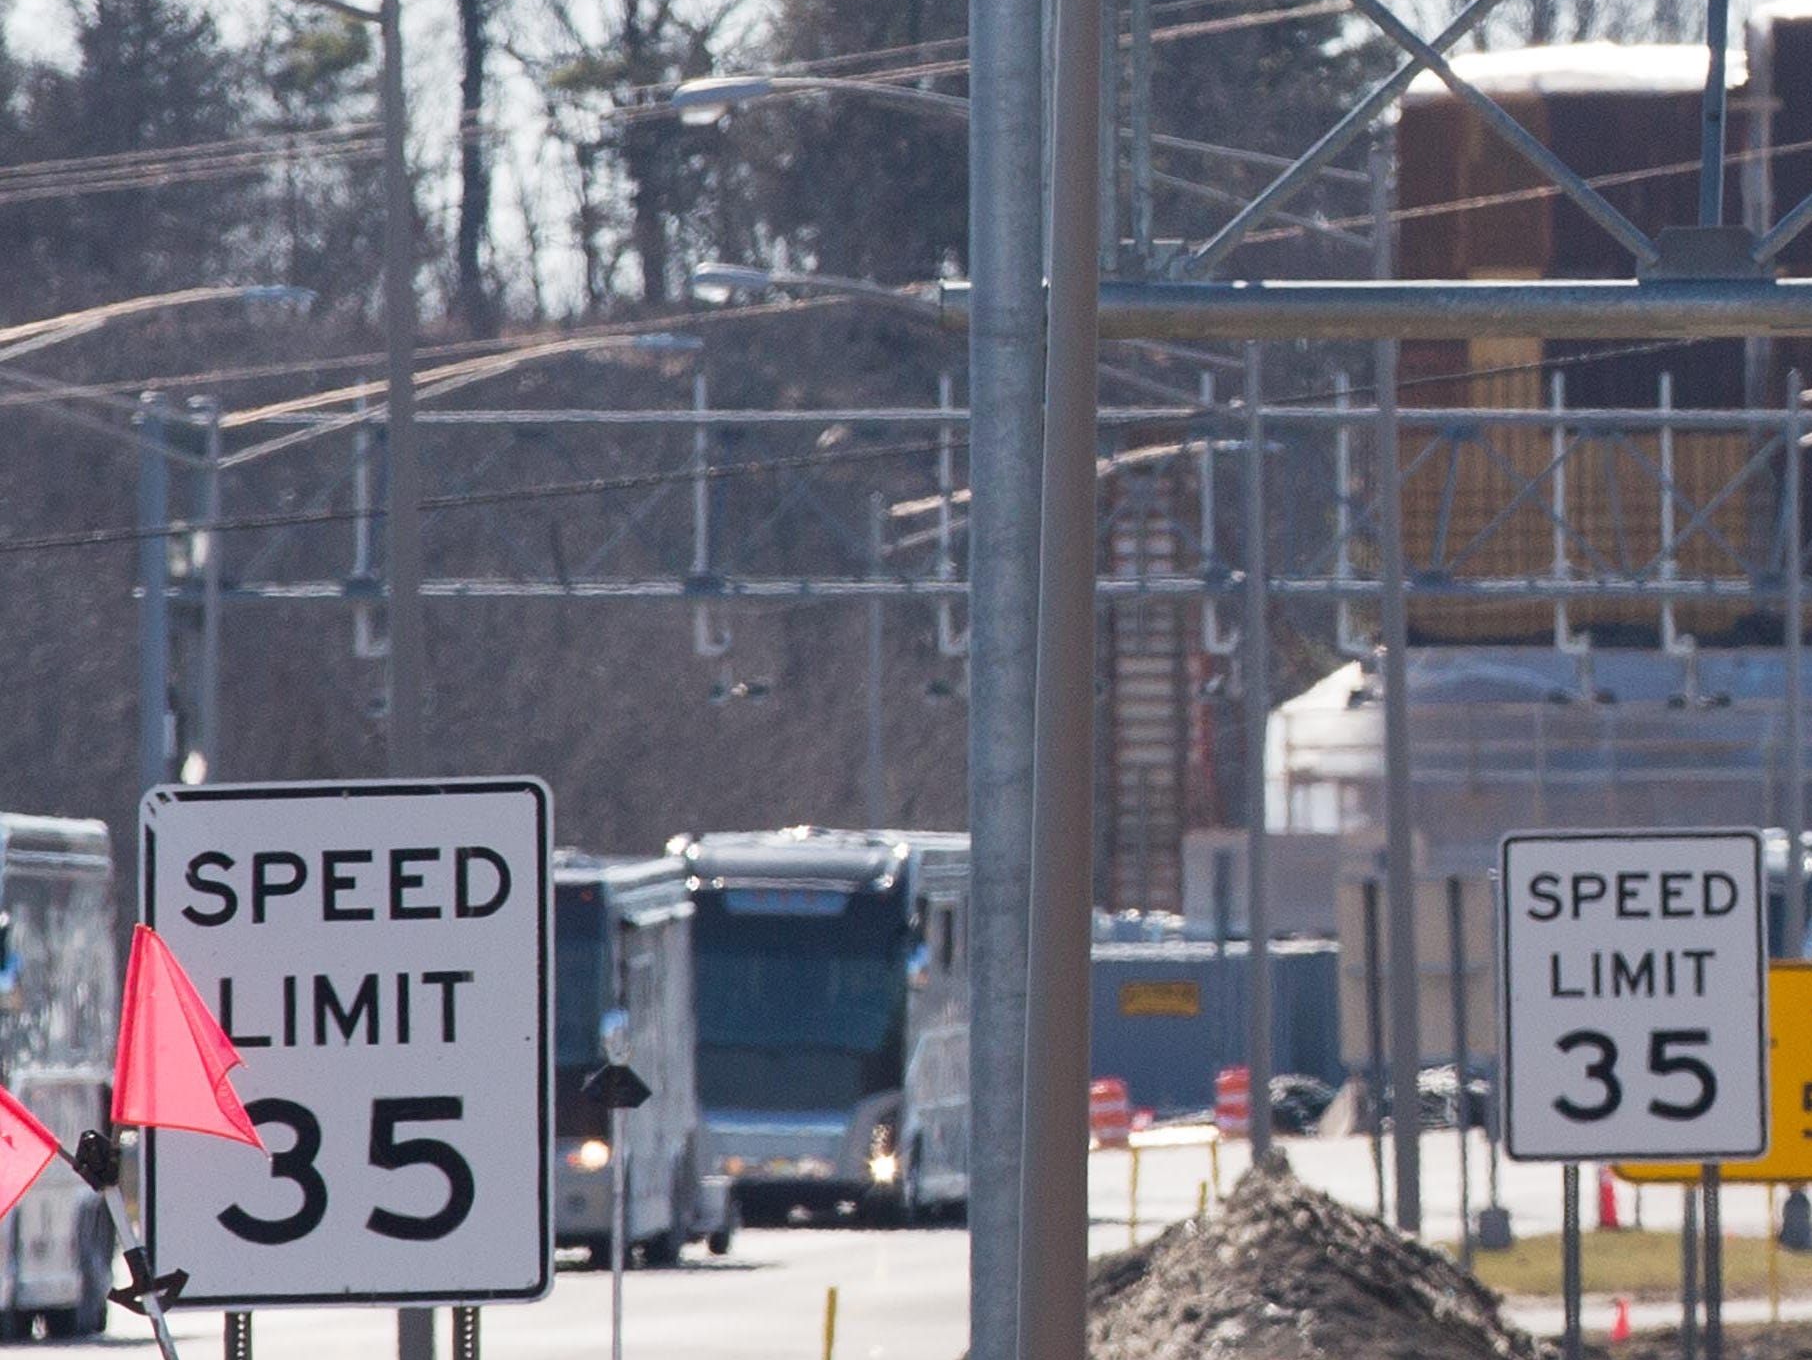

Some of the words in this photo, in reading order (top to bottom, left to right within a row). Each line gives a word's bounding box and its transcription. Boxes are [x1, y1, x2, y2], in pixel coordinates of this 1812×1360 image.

[181, 845, 512, 927] SPEED
[1527, 871, 1739, 920] SPEED
[219, 969, 474, 1049] LIMIT
[1551, 949, 1716, 998] LIMIT
[1553, 1028, 1719, 1122] 35
[216, 1095, 475, 1247] 35
